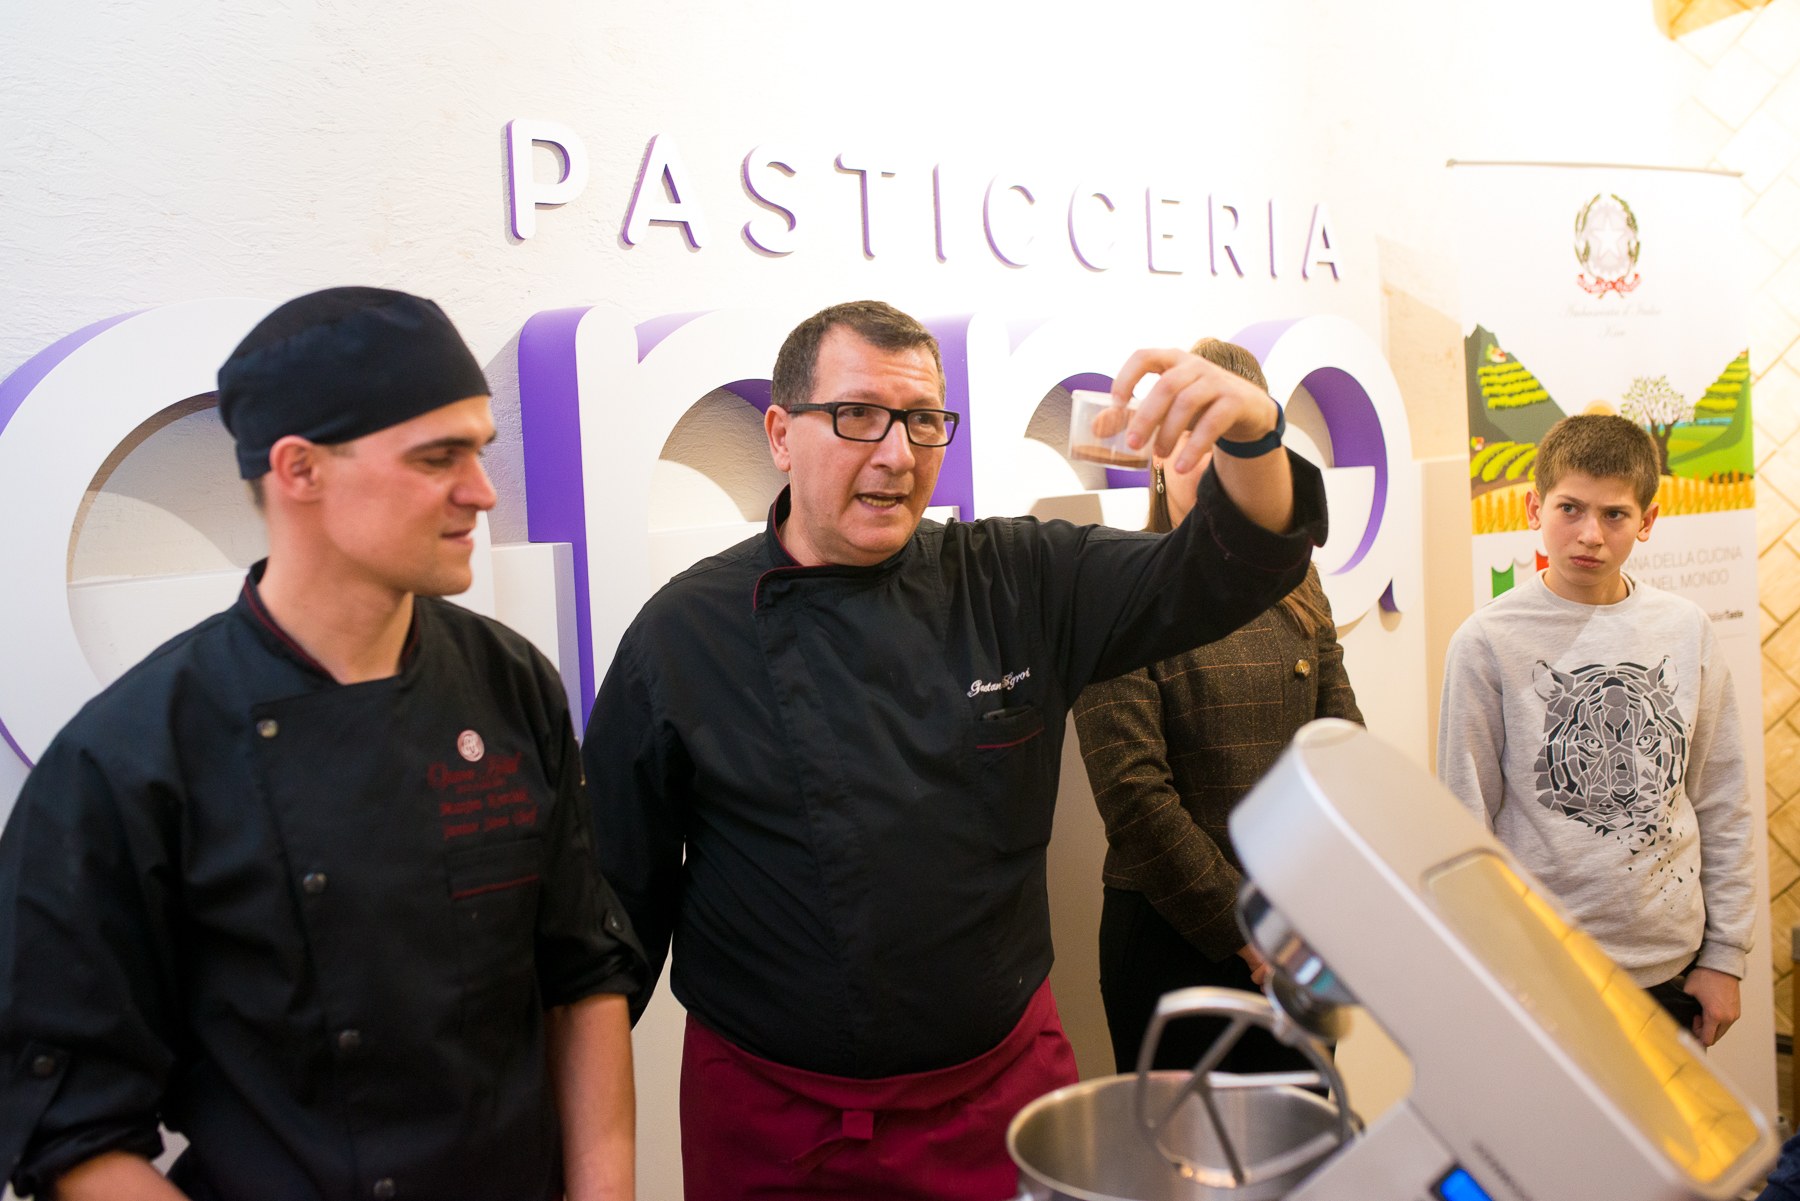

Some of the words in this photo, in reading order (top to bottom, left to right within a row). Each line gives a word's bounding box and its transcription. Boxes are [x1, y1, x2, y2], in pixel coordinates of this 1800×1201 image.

[500, 117, 1343, 283] PASTICCERIA
[1652, 550, 1694, 570] DELLA
[1696, 545, 1743, 566] CUCINA
[1650, 574, 1678, 591] NEL
[1680, 568, 1729, 589] MONDO
